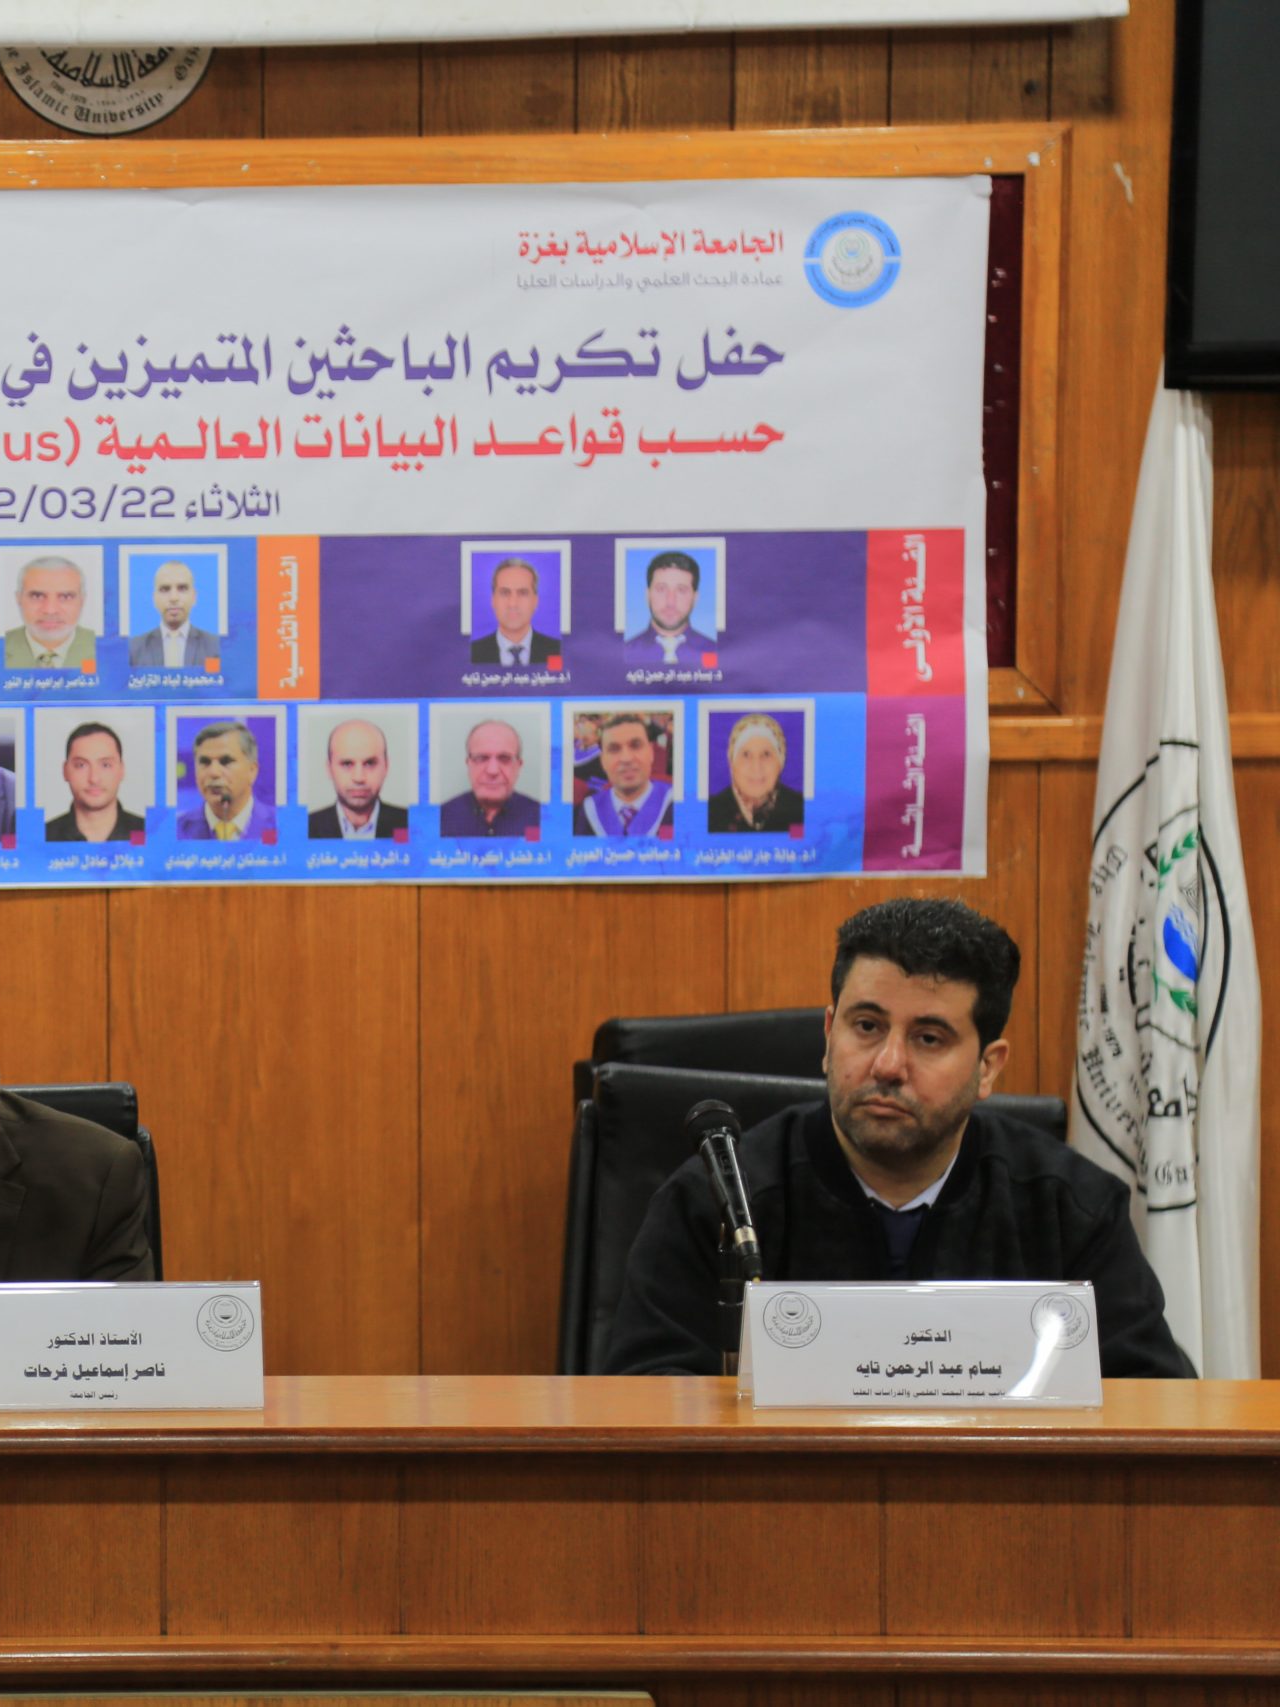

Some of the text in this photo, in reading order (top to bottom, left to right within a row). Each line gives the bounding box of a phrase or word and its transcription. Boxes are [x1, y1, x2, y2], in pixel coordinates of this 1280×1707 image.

[74, 91, 164, 125] University
[520, 233, 568, 264] بغزة
[576, 232, 684, 263] الإسلامية
[693, 230, 783, 261] الجامعة
[1, 333, 52, 407] في
[68, 334, 271, 400] المتميزين
[288, 325, 470, 399] الباحثين
[487, 330, 660, 395] تكريم
[676, 327, 784, 390] حفل
[96, 416, 281, 474] العالمية
[294, 413, 457, 471] البيانات
[473, 408, 624, 467] قواعد
[638, 423, 784, 468] حسب
[185, 484, 279, 519] الثلاثاء
[47, 1332, 95, 1349] الدكتور
[903, 1329, 952, 1345] الدكتور
[24, 1362, 165, 1382] ناصر إسماعيل فرحات
[857, 1361, 1002, 1378] بسام عبد الرحمن تايه
